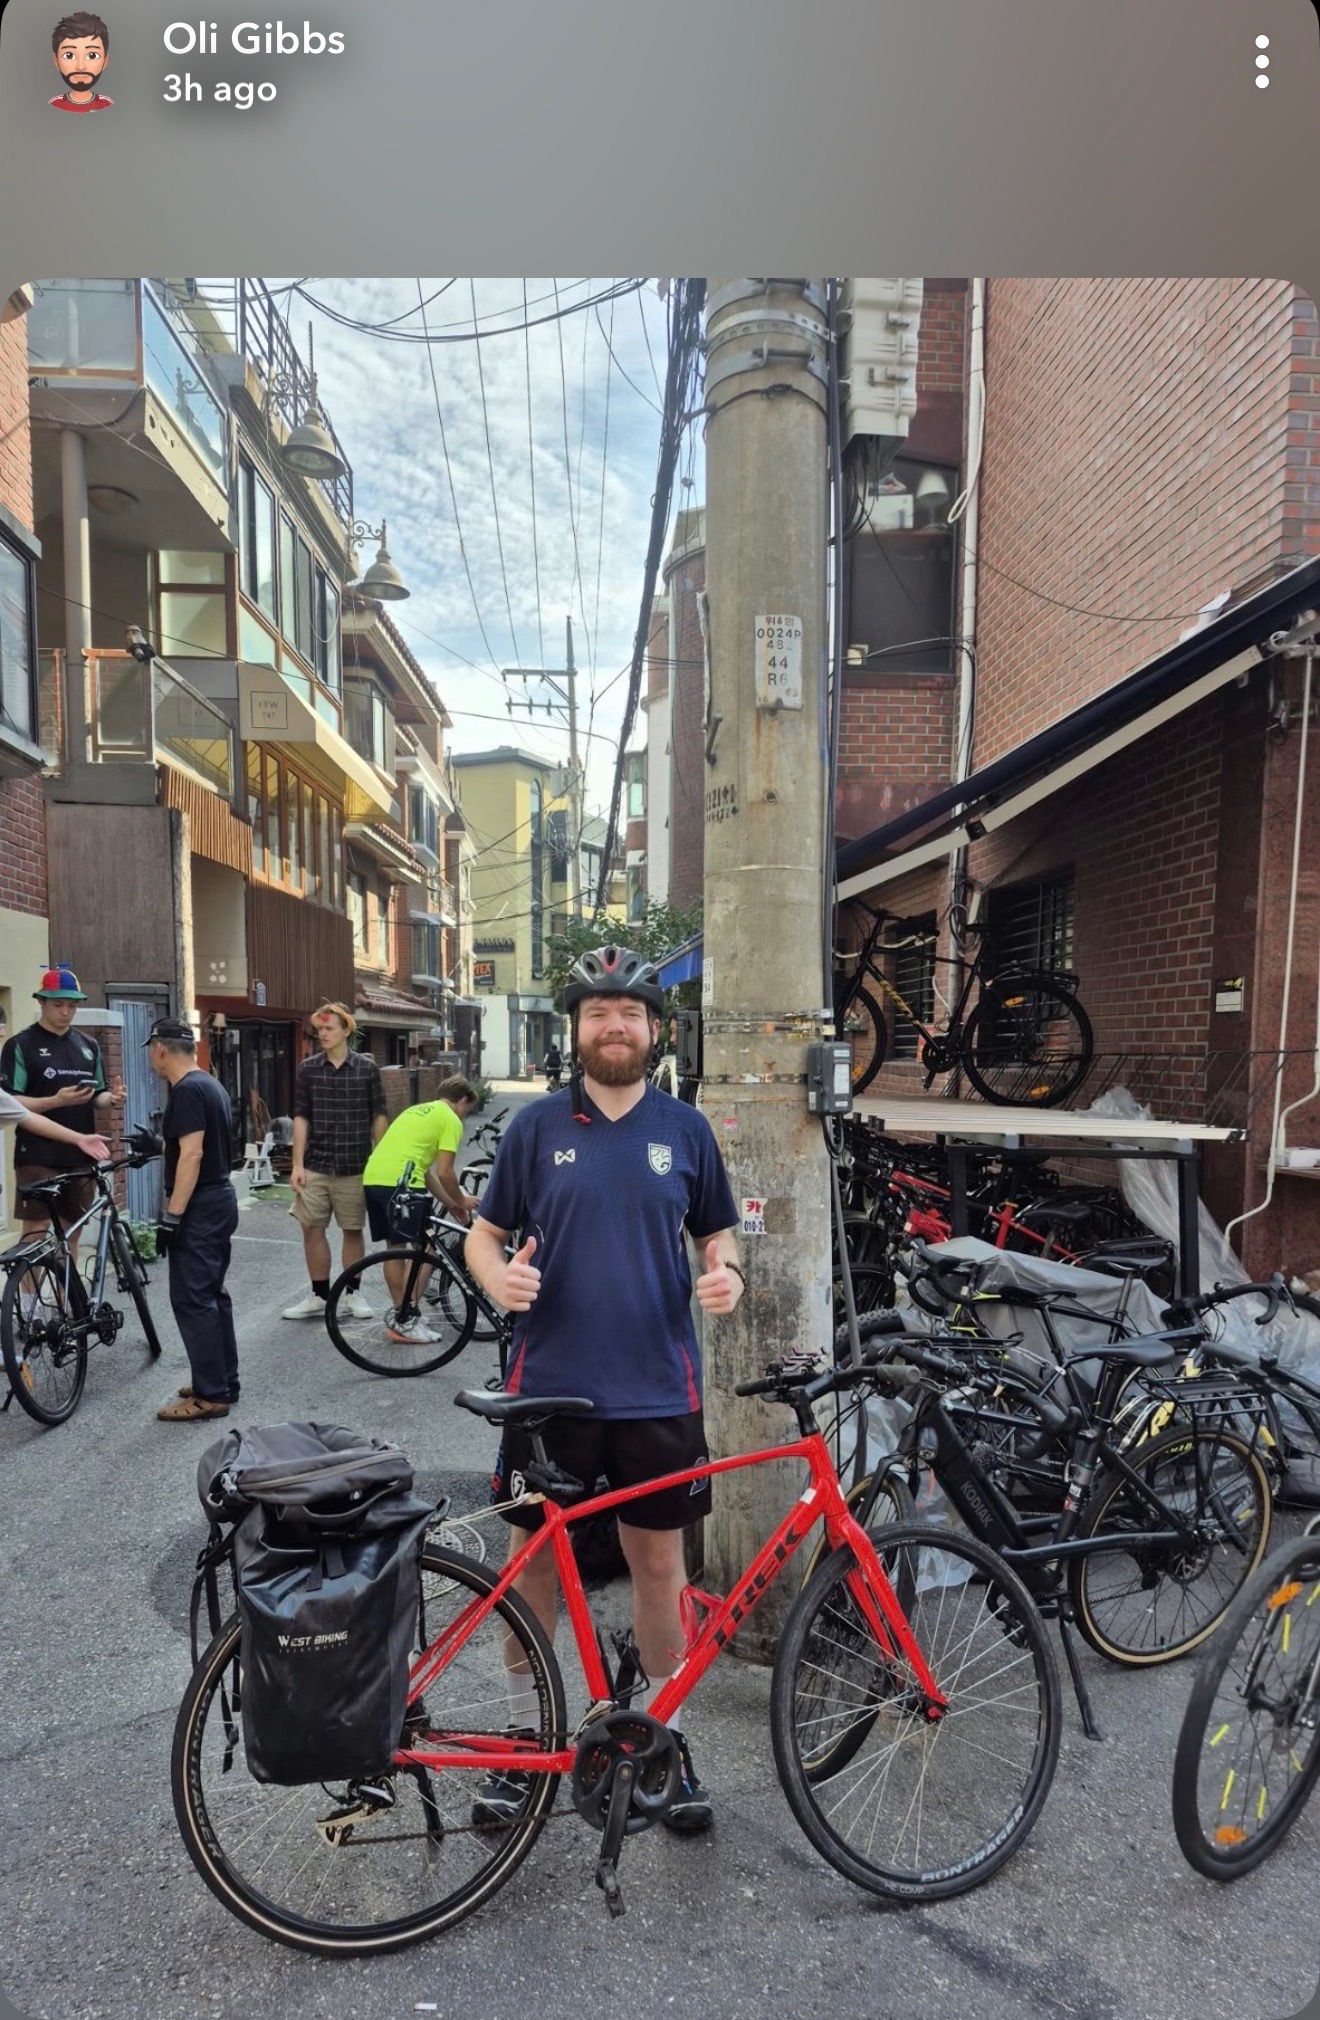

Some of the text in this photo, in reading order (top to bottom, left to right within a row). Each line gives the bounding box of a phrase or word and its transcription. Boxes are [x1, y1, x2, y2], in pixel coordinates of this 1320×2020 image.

[757, 628, 802, 639] 0024P
[768, 656, 788, 669] 44
[960, 1480, 994, 1528] KODIAK
[704, 1523, 803, 1648] TREK
[314, 1630, 349, 1645] BIKING
[528, 1649, 551, 1754] ONNECTION
[921, 1804, 1025, 1883] BONTRAGER
[900, 1884, 925, 1895] COMP
